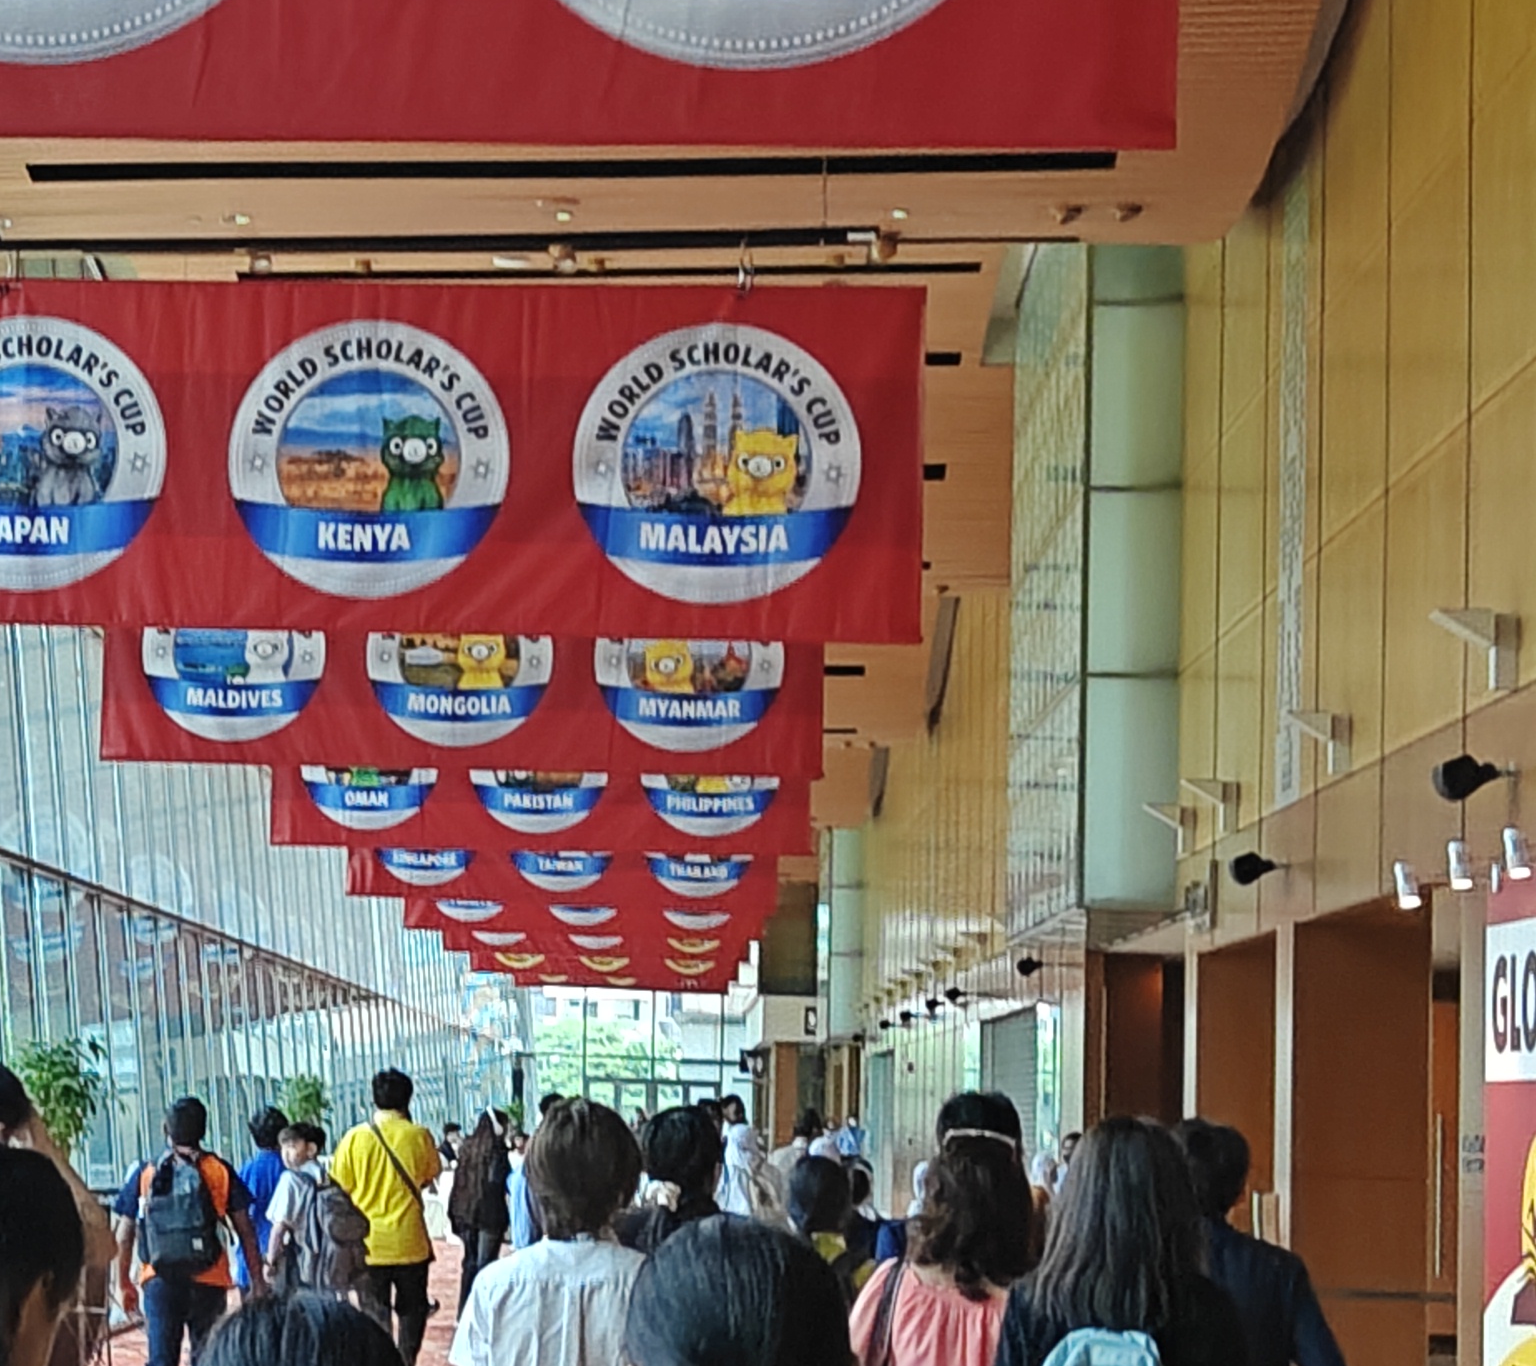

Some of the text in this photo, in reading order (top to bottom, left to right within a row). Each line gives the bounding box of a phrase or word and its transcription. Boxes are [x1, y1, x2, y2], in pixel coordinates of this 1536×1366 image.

[252, 336, 490, 441] WORLD SCHOLAR'S CUP
[595, 341, 841, 447] WORLD SCHOLAR'S CUP
[113, 386, 148, 437] CUP
[317, 521, 411, 553] KENYA
[639, 521, 790, 555] MALAYSIA
[186, 686, 284, 710] MALDIVES
[406, 692, 513, 716] MONGOLIA
[637, 696, 742, 720] MYANMAR
[344, 790, 390, 808] OMAN
[503, 792, 575, 810] PAKISTAN
[1491, 949, 1536, 1054] GLO
